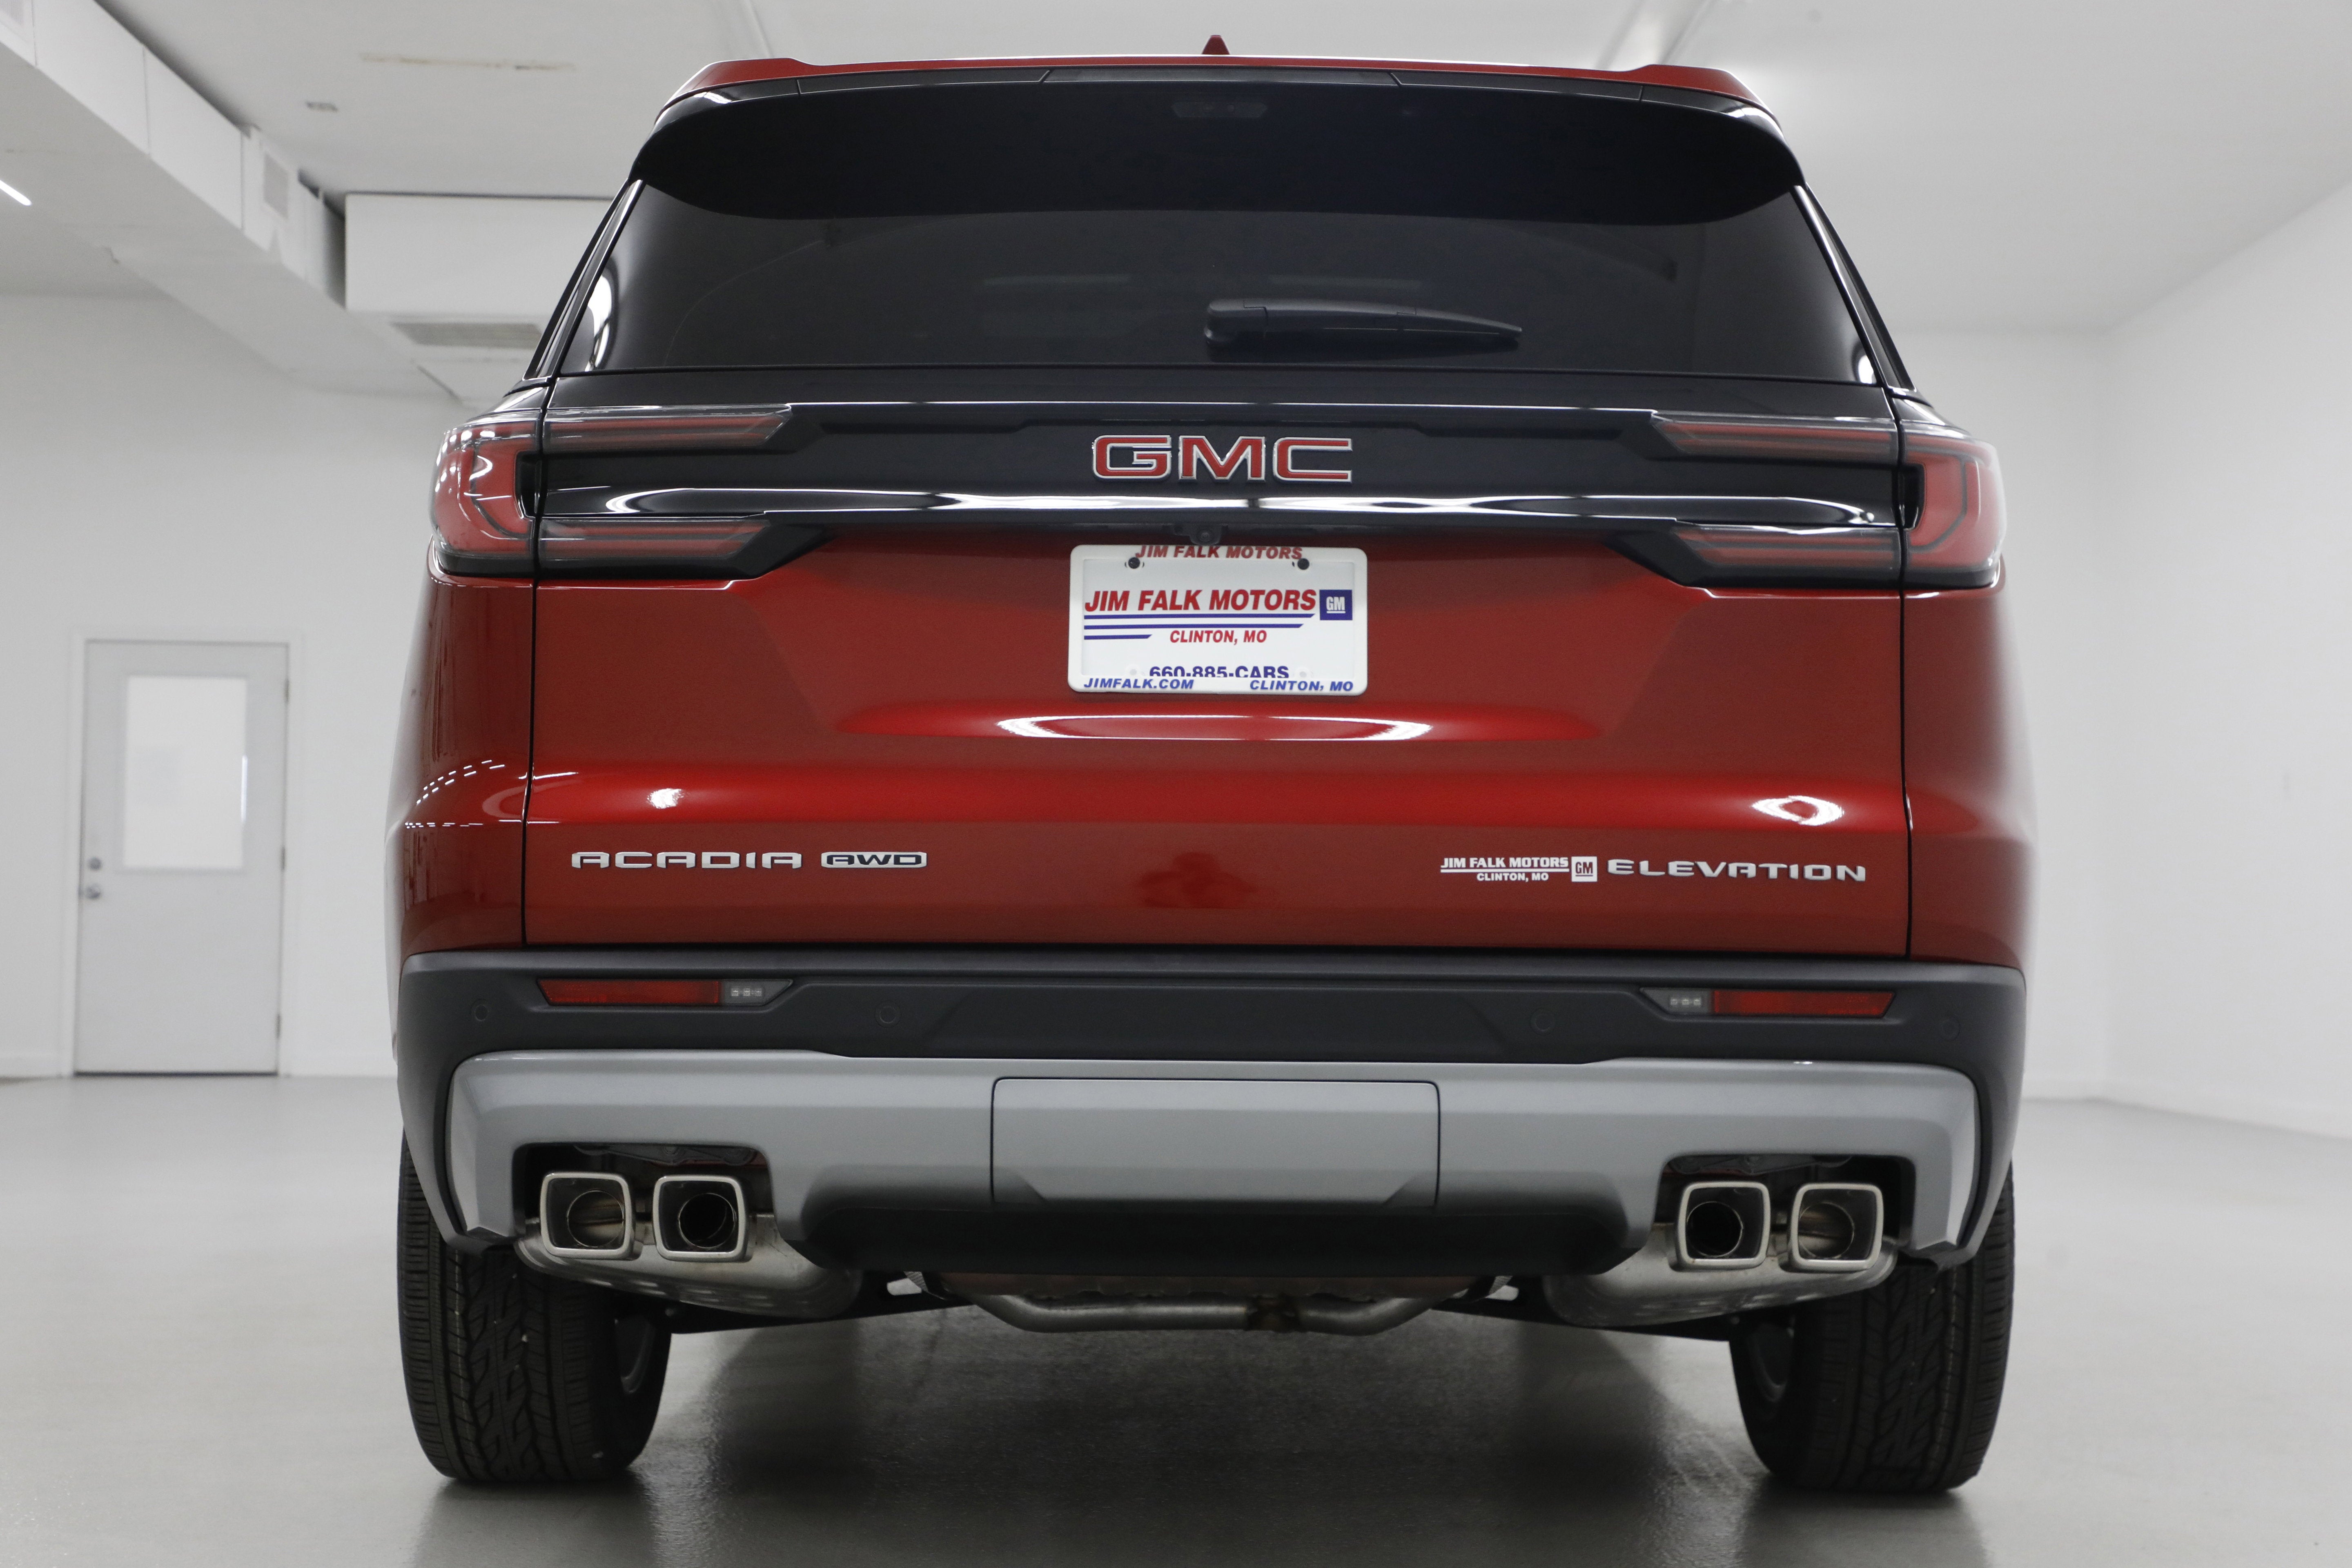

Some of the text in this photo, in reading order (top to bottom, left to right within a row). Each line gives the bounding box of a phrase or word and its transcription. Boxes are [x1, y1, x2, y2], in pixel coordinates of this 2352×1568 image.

[1092, 435, 1352, 483] GMC
[1135, 546, 1303, 559] JIM FALK MOTORS
[1085, 590, 1316, 611] JIM FALK MOTORS
[1326, 597, 1345, 610] GM
[1170, 630, 1267, 645] CLINTON, MO
[1150, 666, 1289, 678] 660-885-CARS
[1084, 678, 1194, 689] JIMFALK.COM
[1250, 680, 1352, 690] CLINTON, MO
[572, 852, 922, 869] ACADIA AWD
[1441, 857, 1568, 868] JIM FALK MOTORS
[1575, 862, 1593, 874] GM
[1608, 859, 1865, 881] ELEVATION
[1477, 873, 1549, 882] CLINTON, MO
